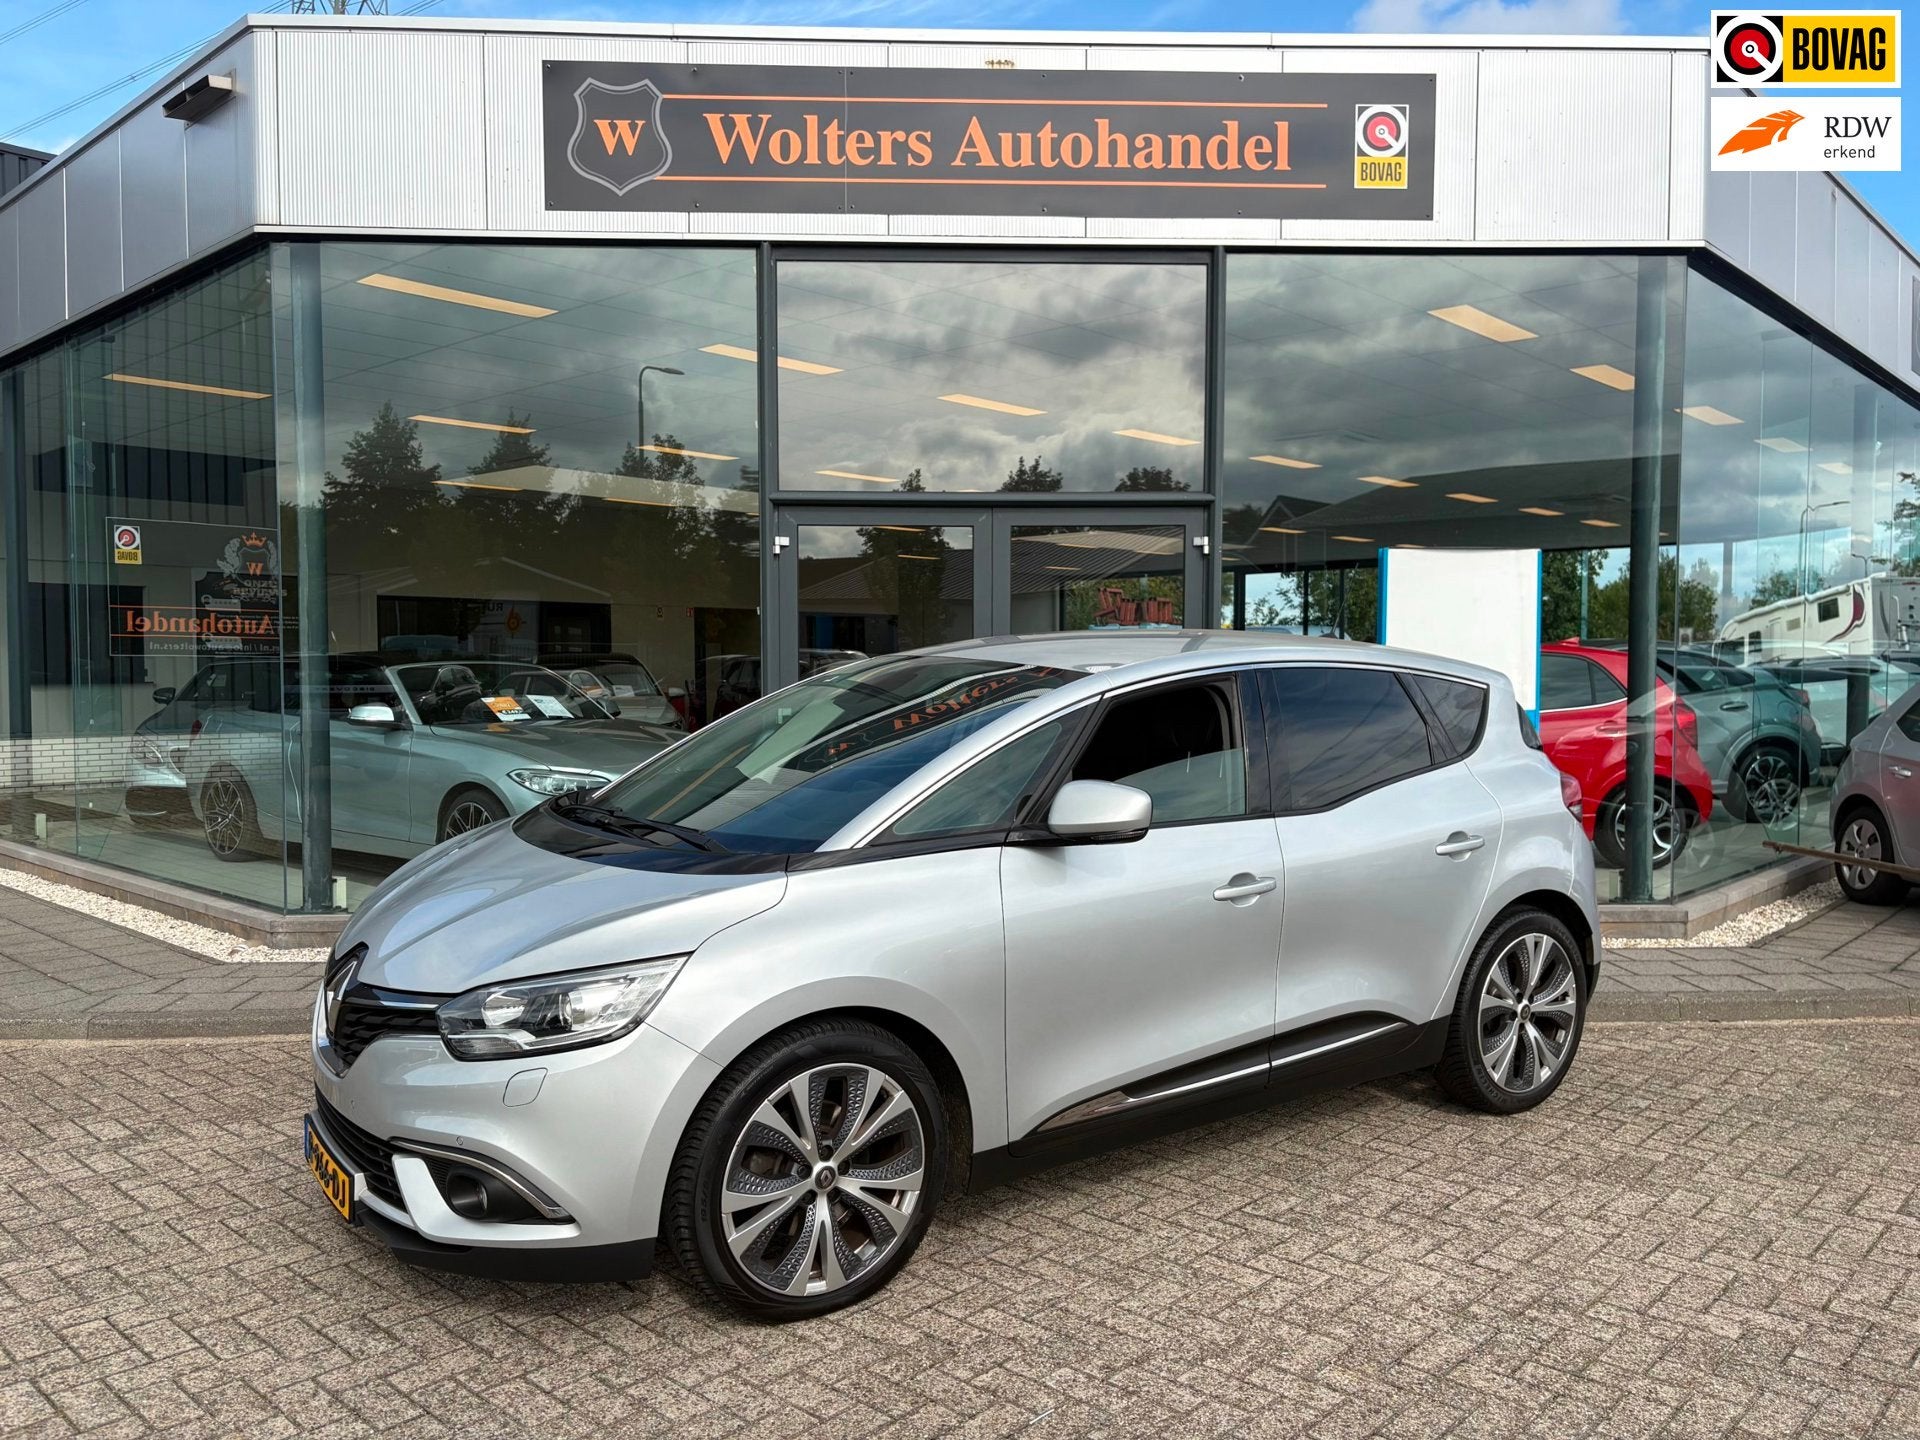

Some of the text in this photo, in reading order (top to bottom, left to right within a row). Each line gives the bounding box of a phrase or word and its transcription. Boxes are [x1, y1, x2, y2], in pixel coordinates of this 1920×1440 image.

[593, 119, 646, 156] W
[702, 113, 1292, 171] Wolters Autohandel
[1360, 162, 1402, 183] BOVAG
